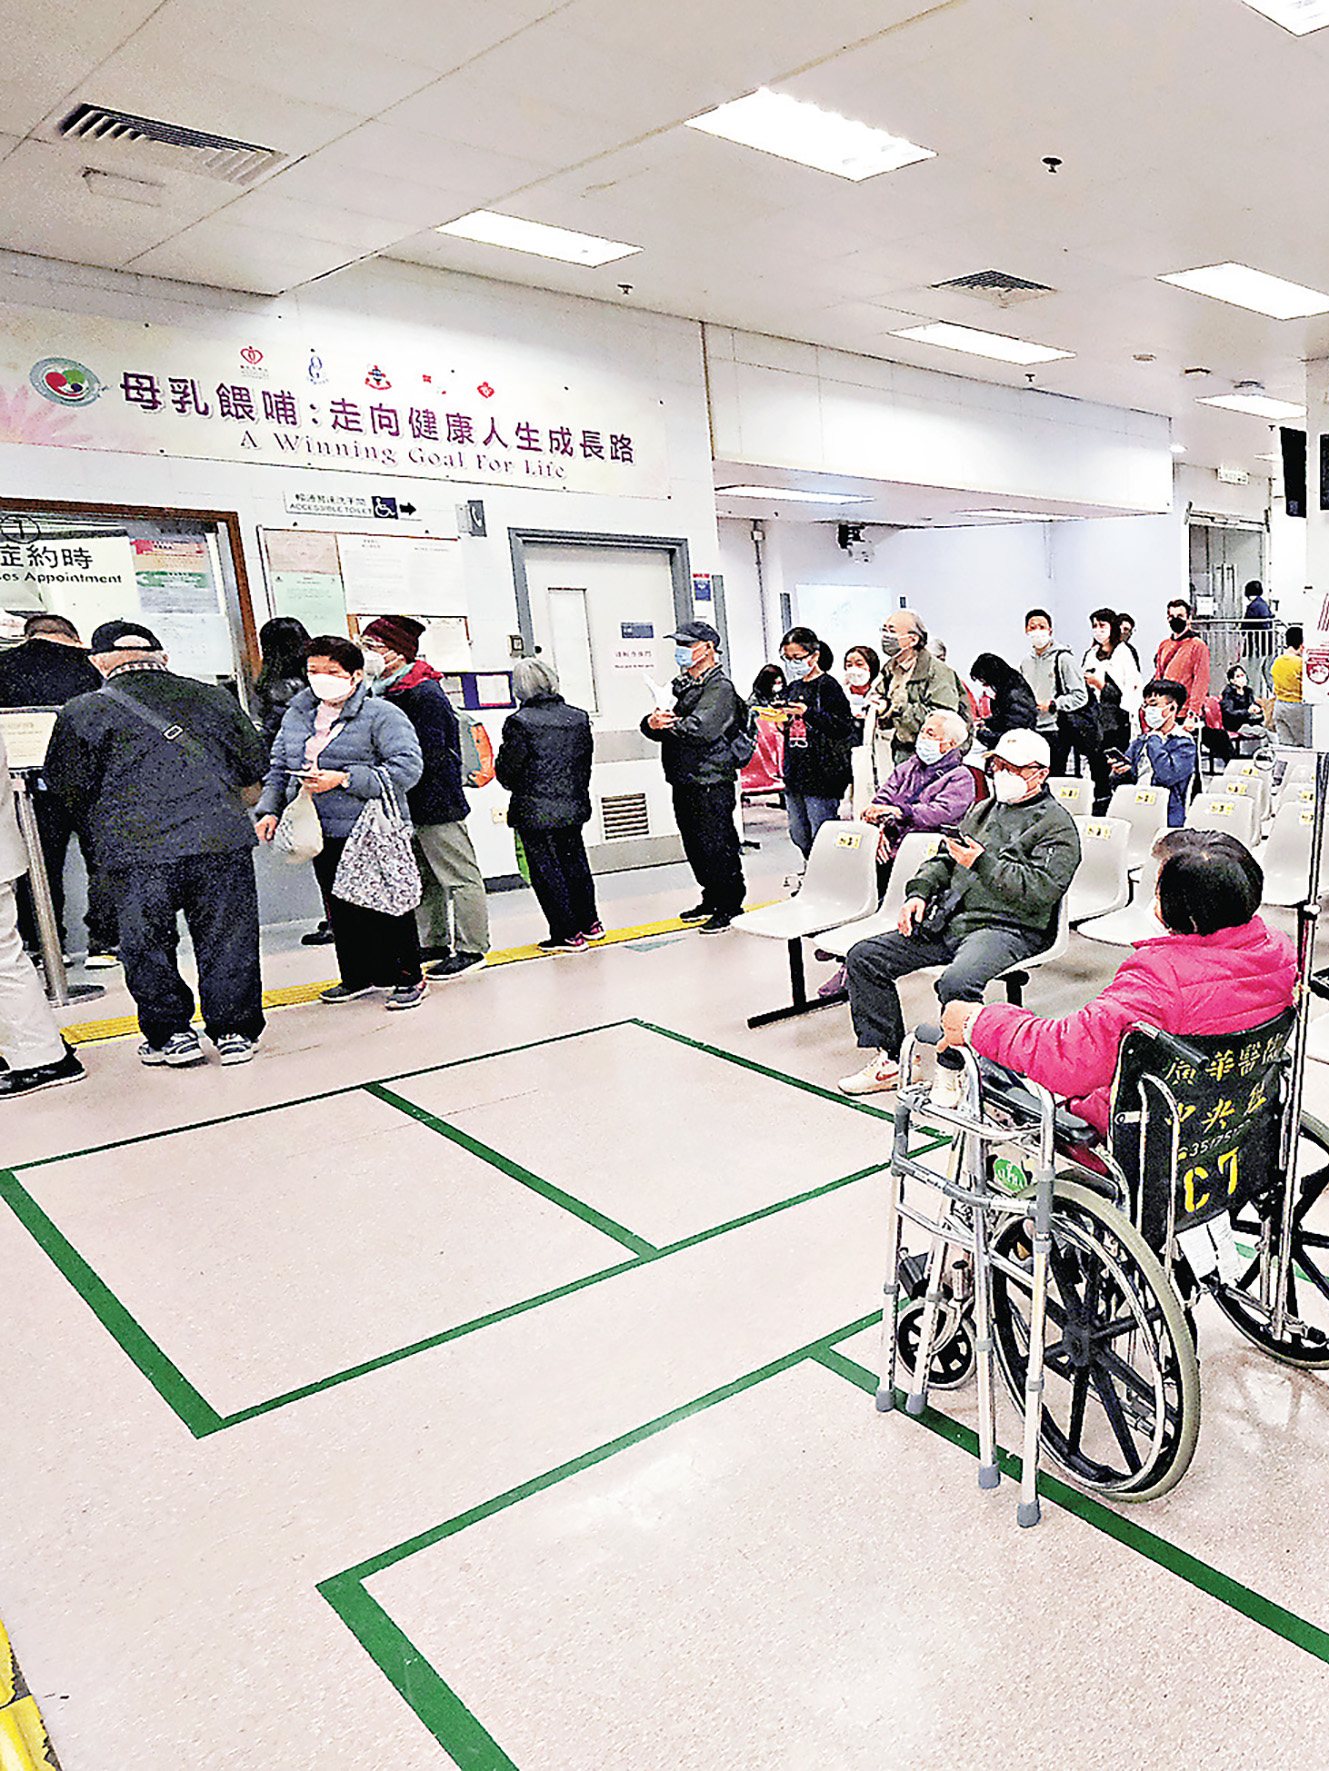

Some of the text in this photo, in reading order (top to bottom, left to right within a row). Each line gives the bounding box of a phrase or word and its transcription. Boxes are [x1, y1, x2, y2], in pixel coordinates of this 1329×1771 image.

[240, 430, 566, 479] A Winning Goal For Life
[290, 503, 372, 514] ACCESSIBLE TOILET
[0, 571, 122, 584] es Appointment
[1183, 1147, 1240, 1213] C7
